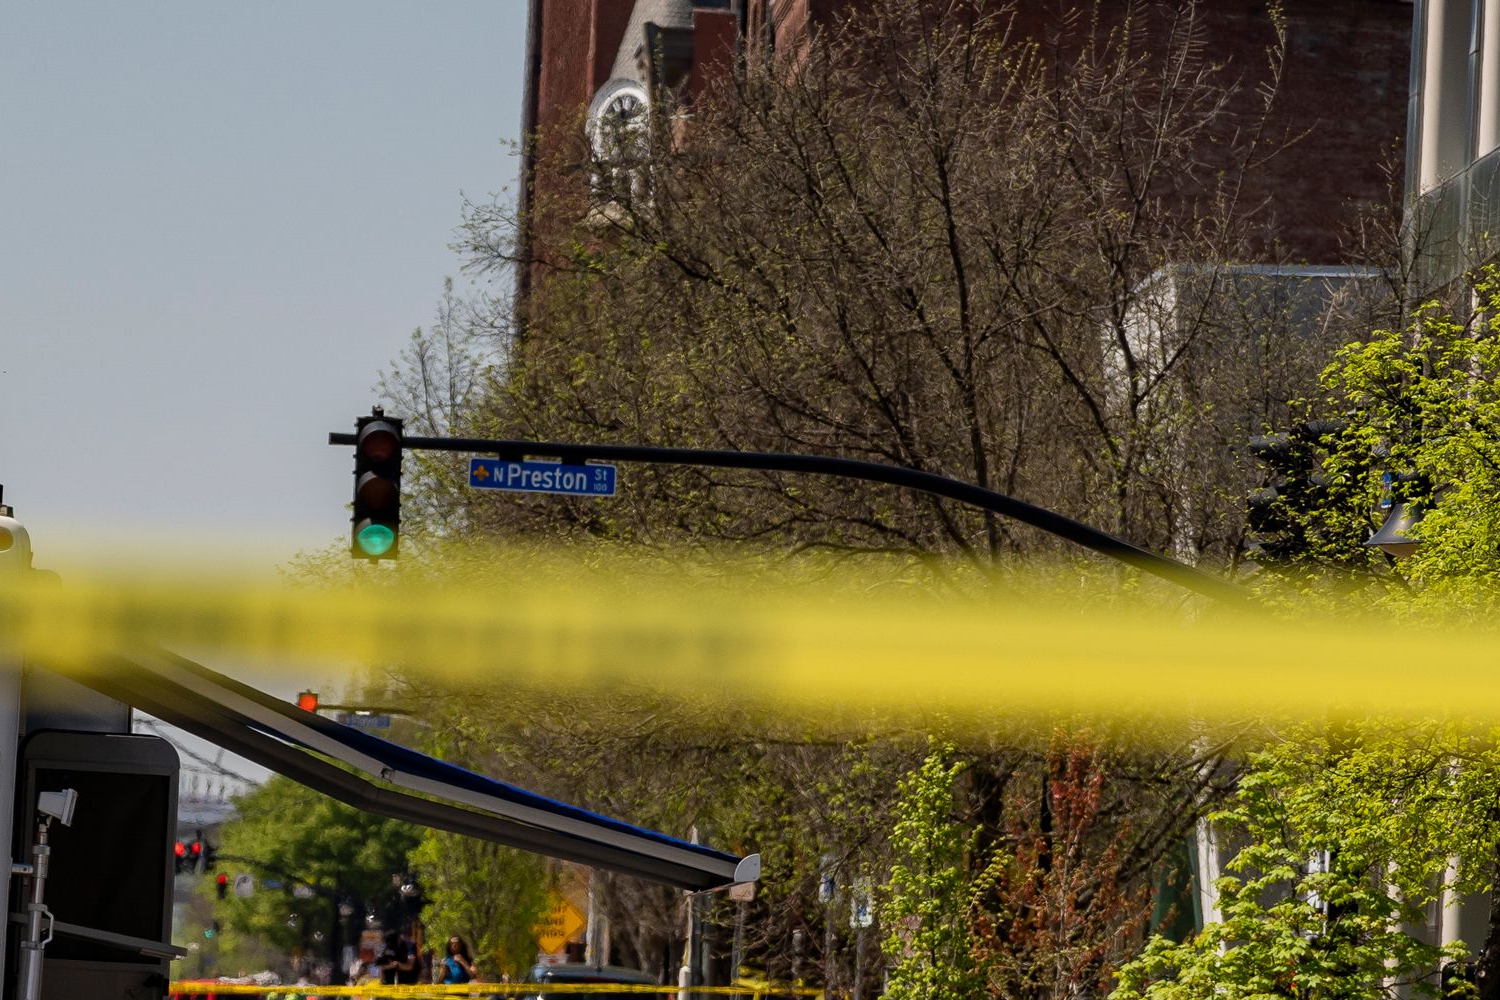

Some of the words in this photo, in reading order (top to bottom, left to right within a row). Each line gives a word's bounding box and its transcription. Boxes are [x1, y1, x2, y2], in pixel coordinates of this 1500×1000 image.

[493, 467, 503, 483] N
[507, 464, 587, 490] Preston
[594, 468, 608, 481] St
[593, 483, 608, 492] 100
